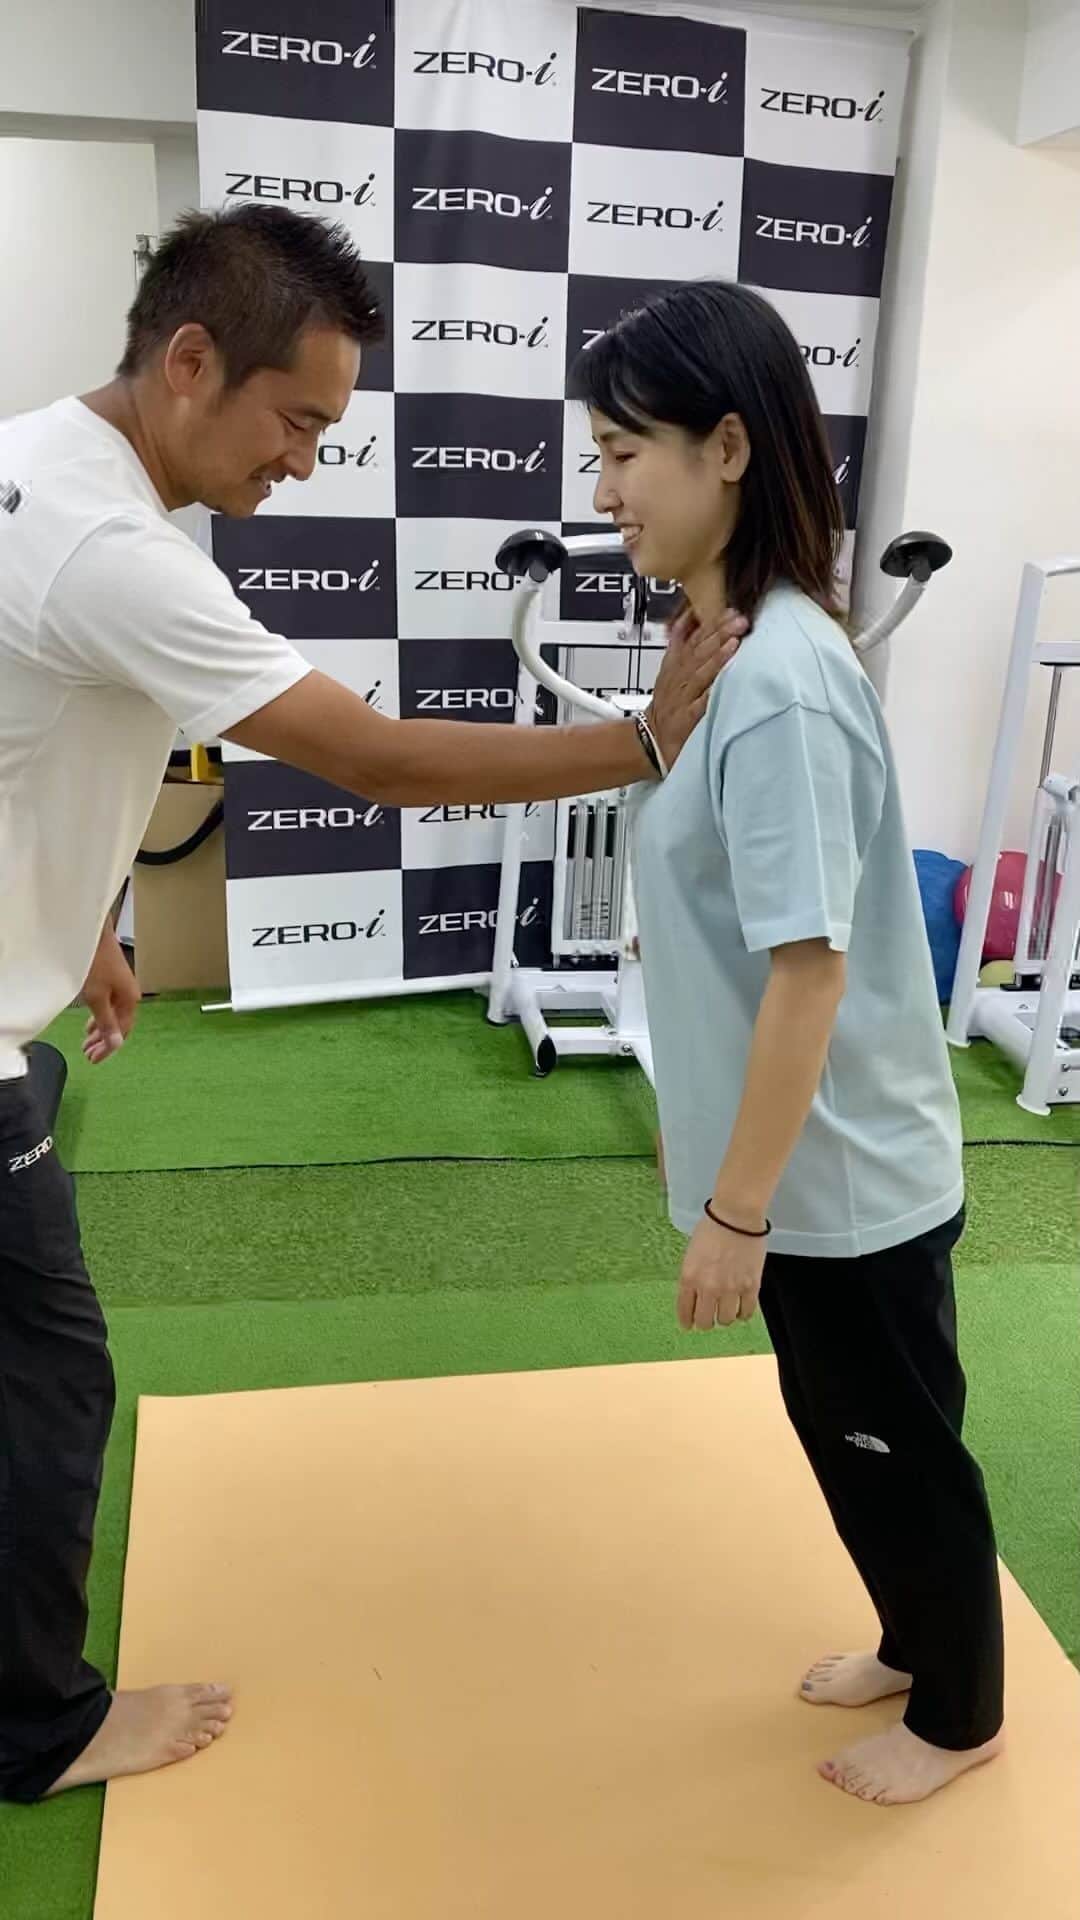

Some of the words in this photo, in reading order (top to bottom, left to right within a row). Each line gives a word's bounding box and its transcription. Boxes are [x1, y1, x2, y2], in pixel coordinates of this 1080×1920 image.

[221, 30, 376, 69] ZERO-i
[413, 51, 558, 86] ZERO-i
[591, 67, 729, 104] ZERO-i
[760, 87, 885, 122] ZERO-i
[225, 172, 376, 207] ZERO-i
[412, 186, 553, 221] ZERO-i
[587, 200, 723, 231] ZERO-i
[755, 214, 872, 248] ZERO-i
[411, 315, 549, 348] ZERO-i
[411, 440, 547, 473] ZERO-i
[238, 559, 380, 592] ZERO-i
[414, 570, 521, 591] ZERO-
[252, 908, 386, 947] ZERO-i
